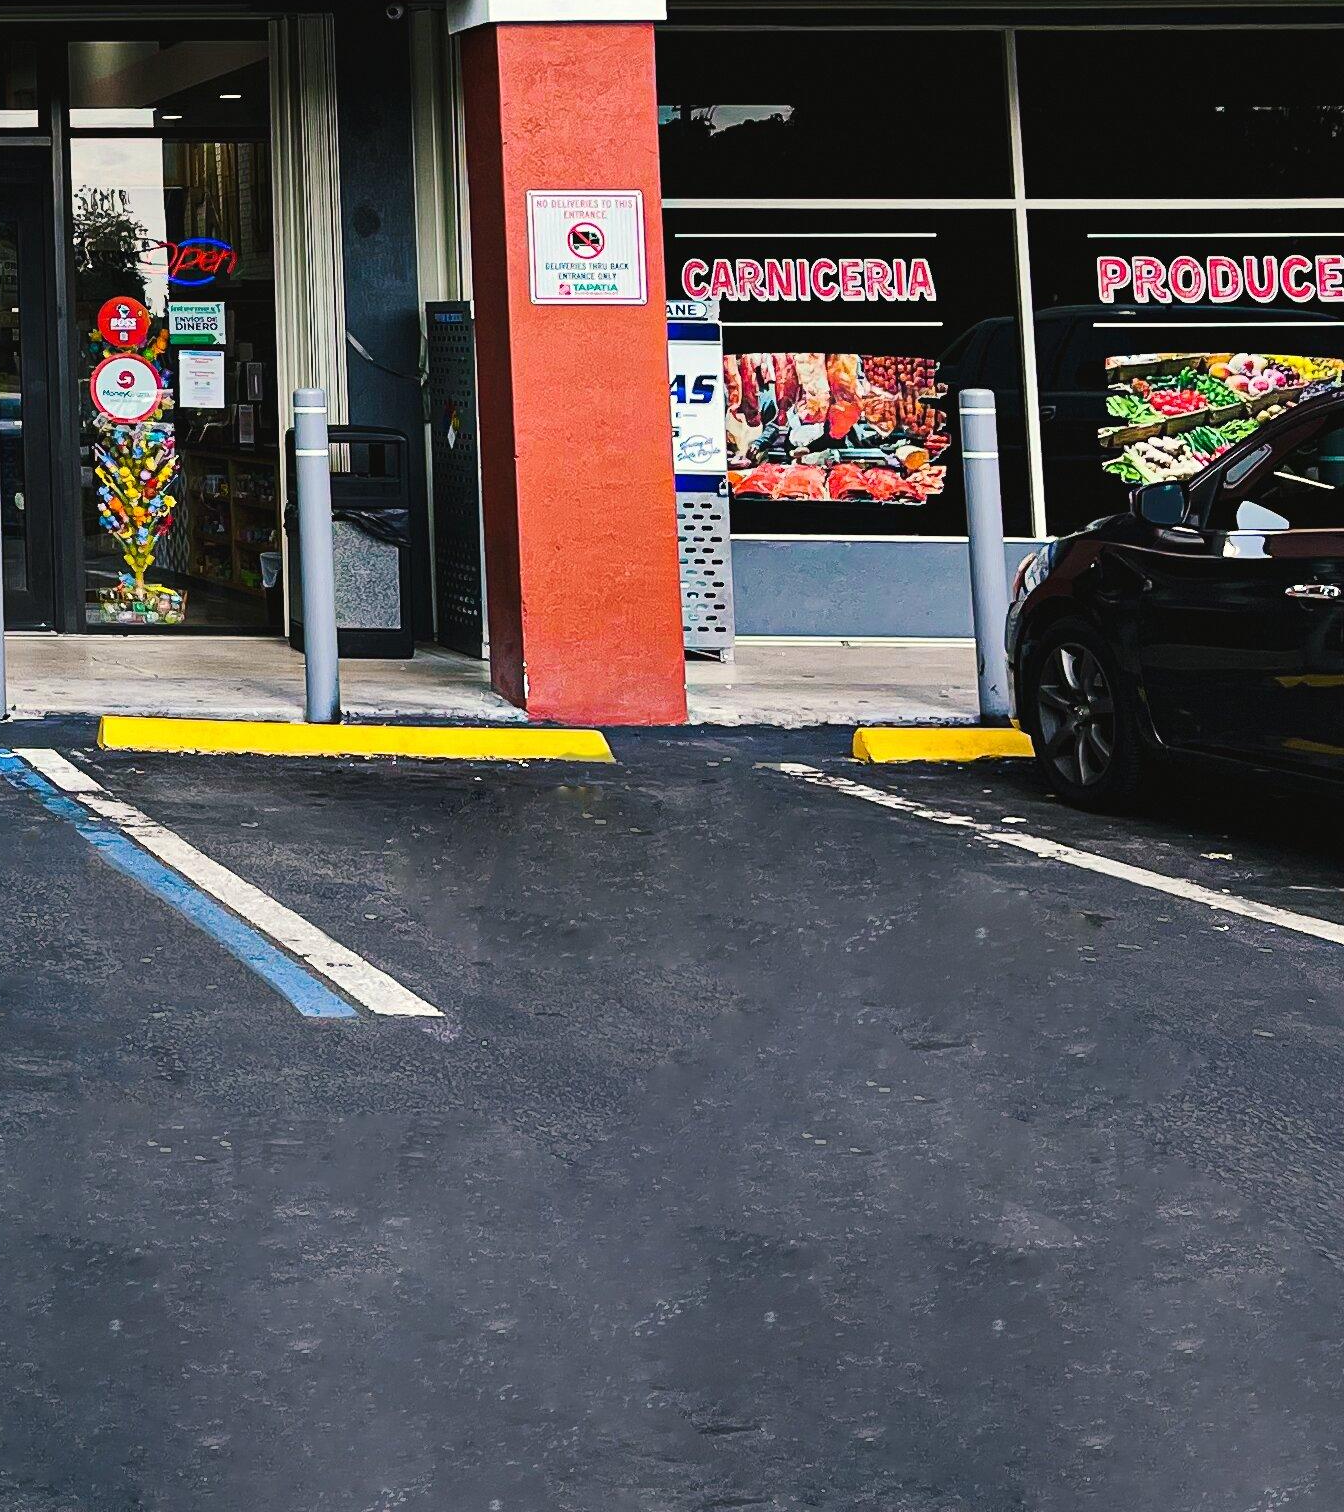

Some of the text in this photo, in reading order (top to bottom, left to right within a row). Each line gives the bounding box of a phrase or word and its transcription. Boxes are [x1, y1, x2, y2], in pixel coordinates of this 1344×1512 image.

[551, 199, 599, 208] DELIVERIES
[615, 199, 633, 208] THIS
[563, 210, 608, 219] ENTRANCE
[545, 263, 587, 271] DELIVERIES
[610, 263, 629, 271] BACK
[558, 272, 617, 281] ENTRANCE ONLY
[681, 257, 937, 302] CARNICERIA
[1095, 254, 1344, 304] PRODUCE
[175, 322, 219, 331] DINERO
